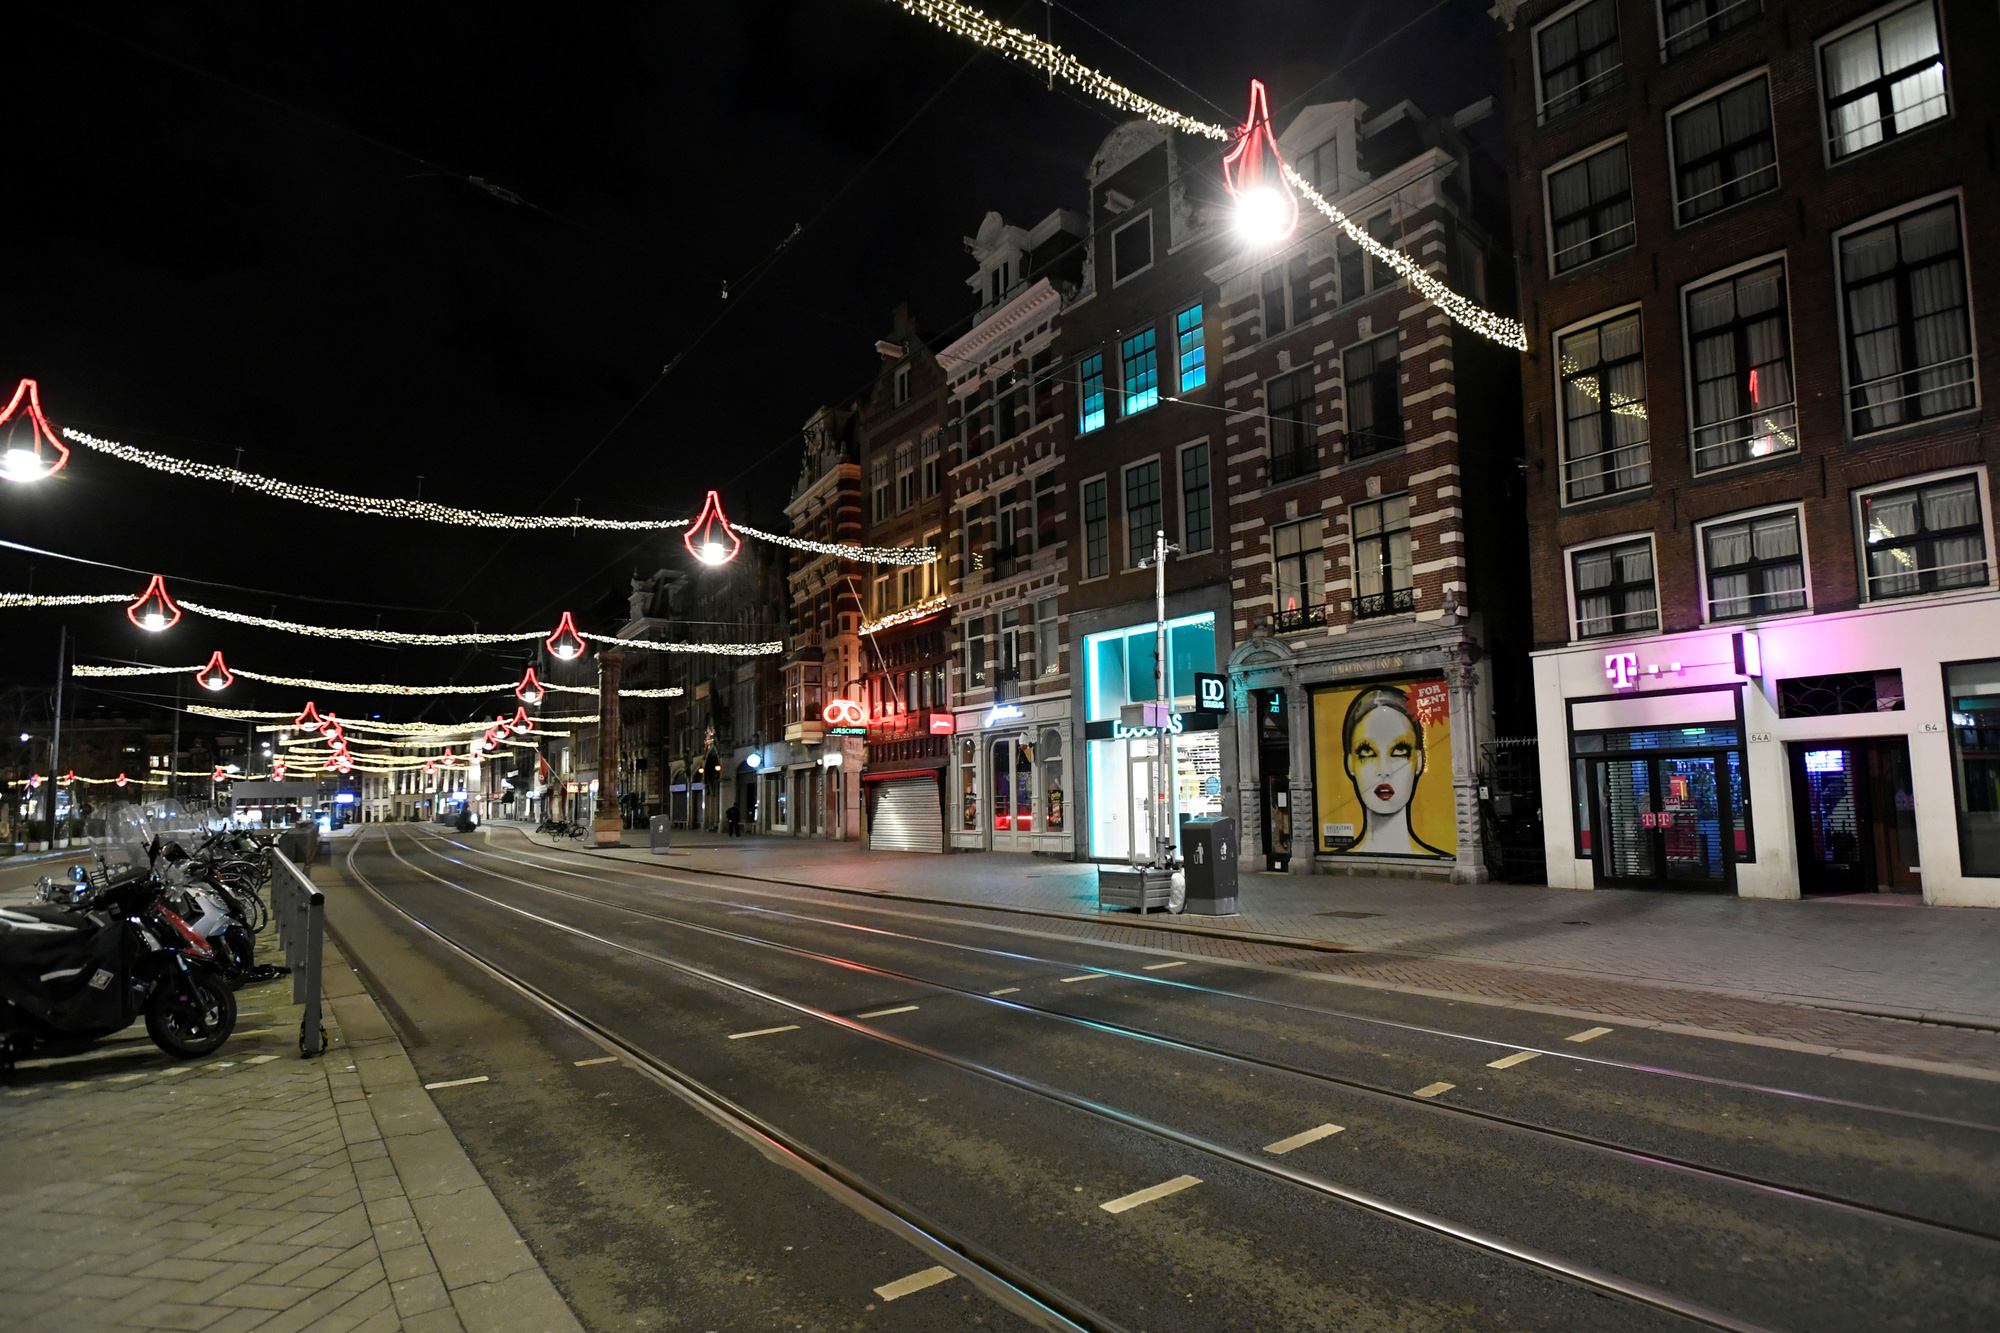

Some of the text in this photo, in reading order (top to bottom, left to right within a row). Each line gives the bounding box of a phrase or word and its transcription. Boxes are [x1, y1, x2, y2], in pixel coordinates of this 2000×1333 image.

[1418, 685, 1441, 697] FOR
[1416, 693, 1446, 707] RENT
[1924, 724, 1938, 732] 64
[1642, 813, 1653, 826] T
[1658, 813, 1670, 826] T
